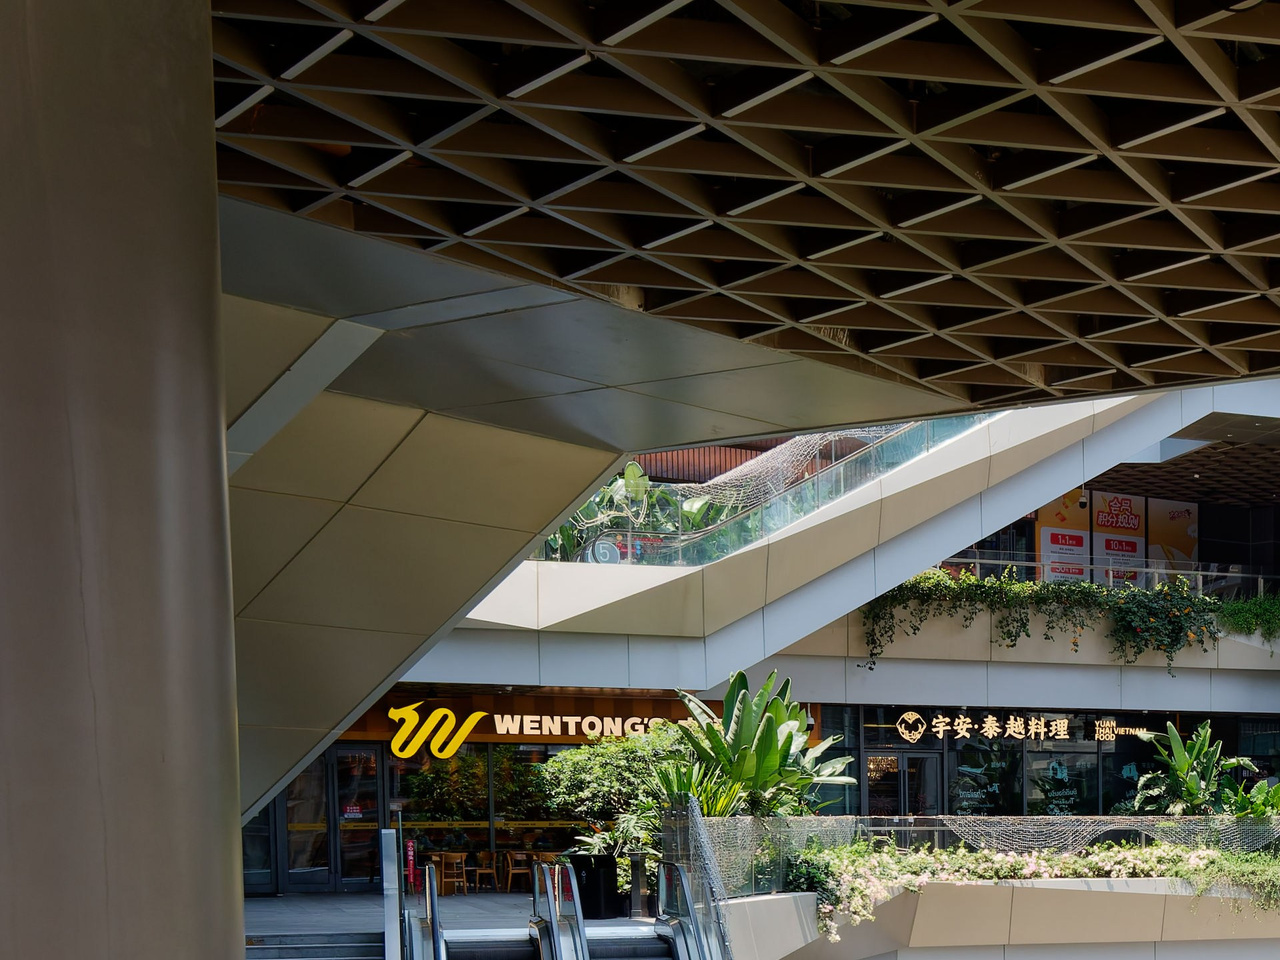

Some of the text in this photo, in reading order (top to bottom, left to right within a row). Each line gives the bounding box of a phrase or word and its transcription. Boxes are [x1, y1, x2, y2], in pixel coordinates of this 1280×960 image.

[1111, 499, 1132, 515] 会员
[1098, 511, 1140, 529] 积分规则
[599, 544, 610, 561] 5
[1095, 720, 1116, 728] YUAN
[1095, 727, 1113, 735] THAI
